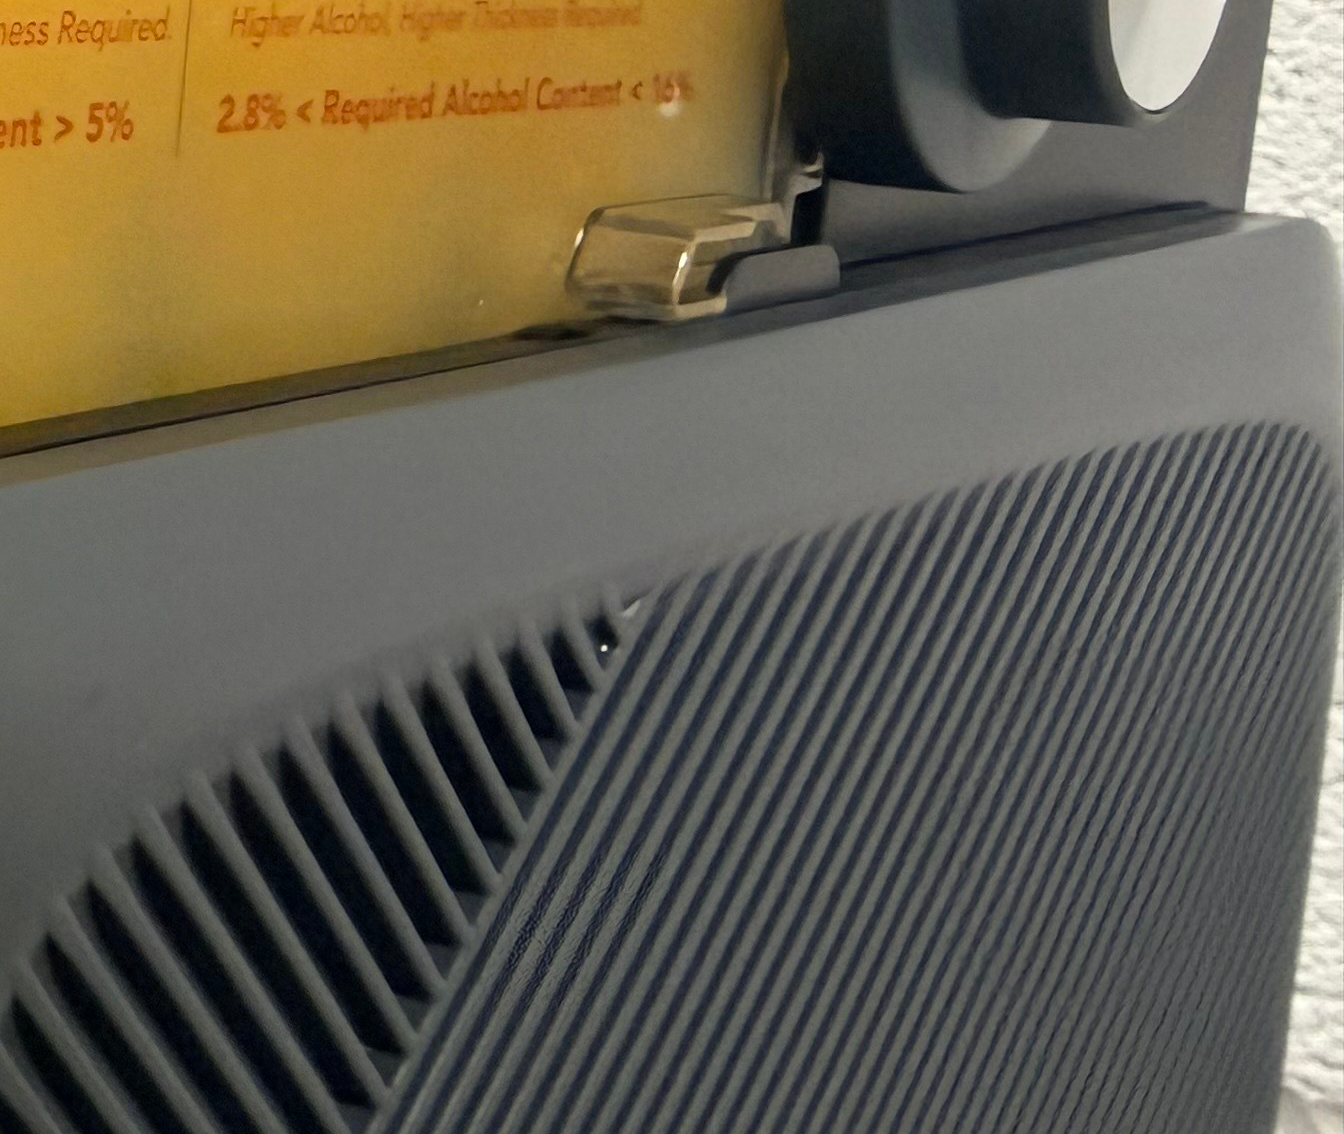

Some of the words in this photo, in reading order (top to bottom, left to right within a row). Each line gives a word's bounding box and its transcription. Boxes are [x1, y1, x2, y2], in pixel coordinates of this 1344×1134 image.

[54, 114, 75, 141] >
[85, 102, 135, 143] 5%
[216, 92, 287, 133] 2.8%
[296, 99, 314, 124] <
[322, 81, 436, 131] Required
[442, 77, 530, 117] Alcohol
[537, 77, 623, 111] Content
[631, 80, 643, 100] <
